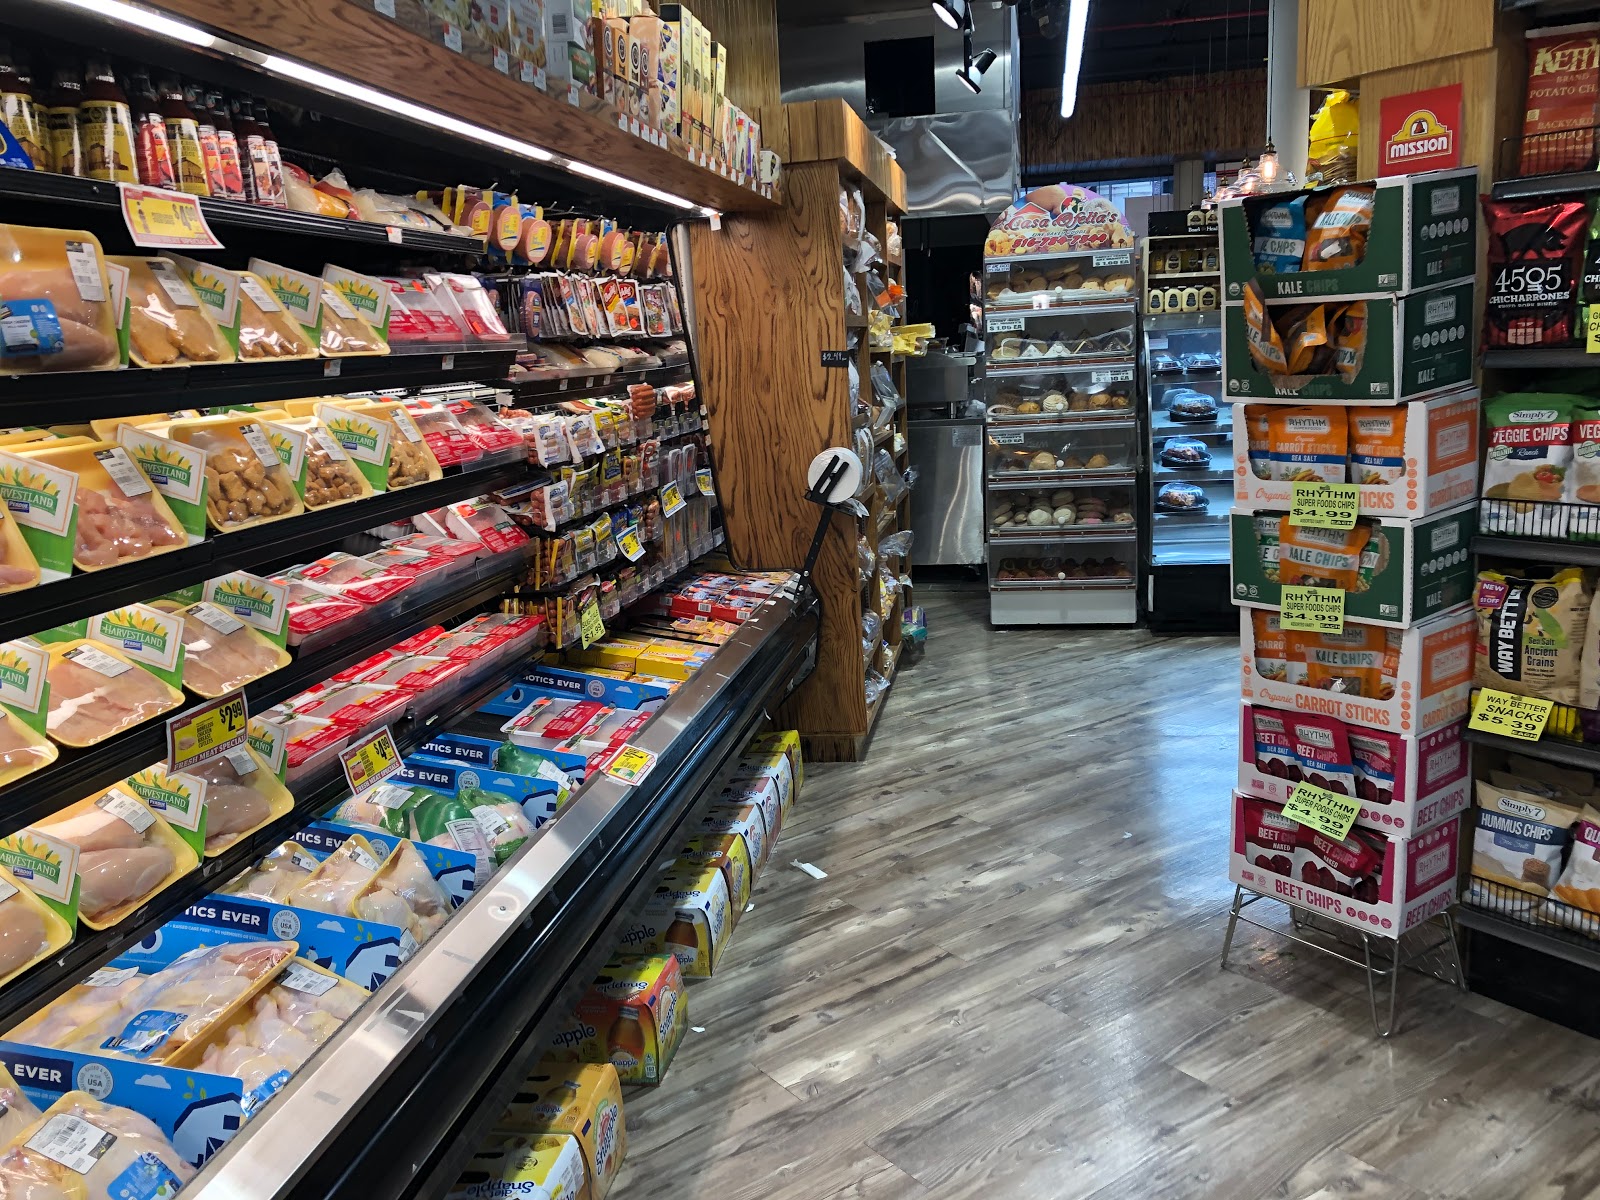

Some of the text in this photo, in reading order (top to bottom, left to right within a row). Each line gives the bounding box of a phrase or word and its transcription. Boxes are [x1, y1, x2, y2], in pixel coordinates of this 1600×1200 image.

[1530, 86, 1575, 98] POTATO
[1537, 117, 1594, 130] BACKYARD
[1003, 217, 1050, 231] Casa
[1495, 264, 1562, 294] 4505
[1277, 279, 1339, 295] KALE CHIPS
[1489, 291, 1570, 304] CHICHARRONES
[1428, 302, 1454, 315] RHYTHM
[1417, 367, 1436, 385] KALE
[1288, 418, 1327, 427] RHYTHM
[1512, 411, 1555, 421] Simply 7
[1358, 419, 1391, 428] RHYTHM
[1493, 427, 1569, 443] VEGGIE CHIPS
[1276, 443, 1337, 454] CARROT STICKS
[1355, 444, 1374, 454] CARROT
[1517, 448, 1539, 456] Ranch
[1291, 454, 1302, 462] SEA
[1255, 487, 1291, 502] Organic
[1296, 489, 1356, 500] RHYTHM
[1297, 499, 1355, 509] SUPER FOODS CHIPS
[1292, 508, 1352, 518] $4.99
[1300, 527, 1345, 541] RHYTHM
[1289, 547, 1349, 568] KALE CHIPS
[1483, 583, 1504, 592] NEW
[217, 592, 270, 613] HARVESTLAND
[1285, 592, 1342, 603] RHYTHM
[1286, 602, 1341, 613] SUPER FOODS CHIPS
[1283, 612, 1339, 622] $4.99
[104, 624, 163, 648] HARVESTLAND
[1528, 637, 1555, 646] Sea Salt
[1316, 649, 1373, 665] KALE CHIPS
[1498, 640, 1514, 673] WAY
[1525, 645, 1558, 656] Ancient
[1527, 655, 1555, 668] Grains
[557, 680, 581, 690] EVER
[1260, 688, 1293, 703] Organic
[1295, 694, 1390, 726] CARROT STICKS
[1486, 695, 1548, 713] WAY BETTER
[1485, 704, 1545, 723] SNACKS
[1477, 713, 1537, 731] $5.39
[1299, 728, 1330, 739] RHYTHM
[174, 748, 218, 771] FRESH MEAT
[455, 748, 483, 759] EVER
[1297, 744, 1337, 763] BEET CHIPS
[1429, 748, 1457, 770] RHYTHM
[1316, 762, 1326, 770] SALT
[418, 771, 449, 783] EVER
[131, 783, 187, 807] HARVESTLAND
[1298, 788, 1355, 815] RHYTHM
[1294, 795, 1351, 823] SUPER FOODS CHIPS
[1417, 788, 1464, 828] BEET CHIPS
[1501, 799, 1541, 817] Simply 7
[1287, 803, 1344, 829] $4.99
[1258, 827, 1280, 841] BEET
[1481, 813, 1553, 841] HUMMUS CHIPS
[1273, 843, 1291, 851] NAKED
[1313, 835, 1358, 868] BEET CHIPS
[1323, 855, 1339, 868] NAKED
[1419, 851, 1447, 873] RHYTHM
[13, 867, 33, 878] PERDUE
[656, 890, 701, 900] Snapple
[1275, 879, 1342, 914] BEET CHIPS
[1405, 888, 1452, 928] BEET CHIPS
[212, 910, 261, 926] EVER
[597, 981, 648, 992] Snapple
[14, 1064, 62, 1083] EVER
[87, 1079, 103, 1087] USA
[596, 1104, 618, 1176] Snapple
[467, 1181, 535, 1197] Snapple
